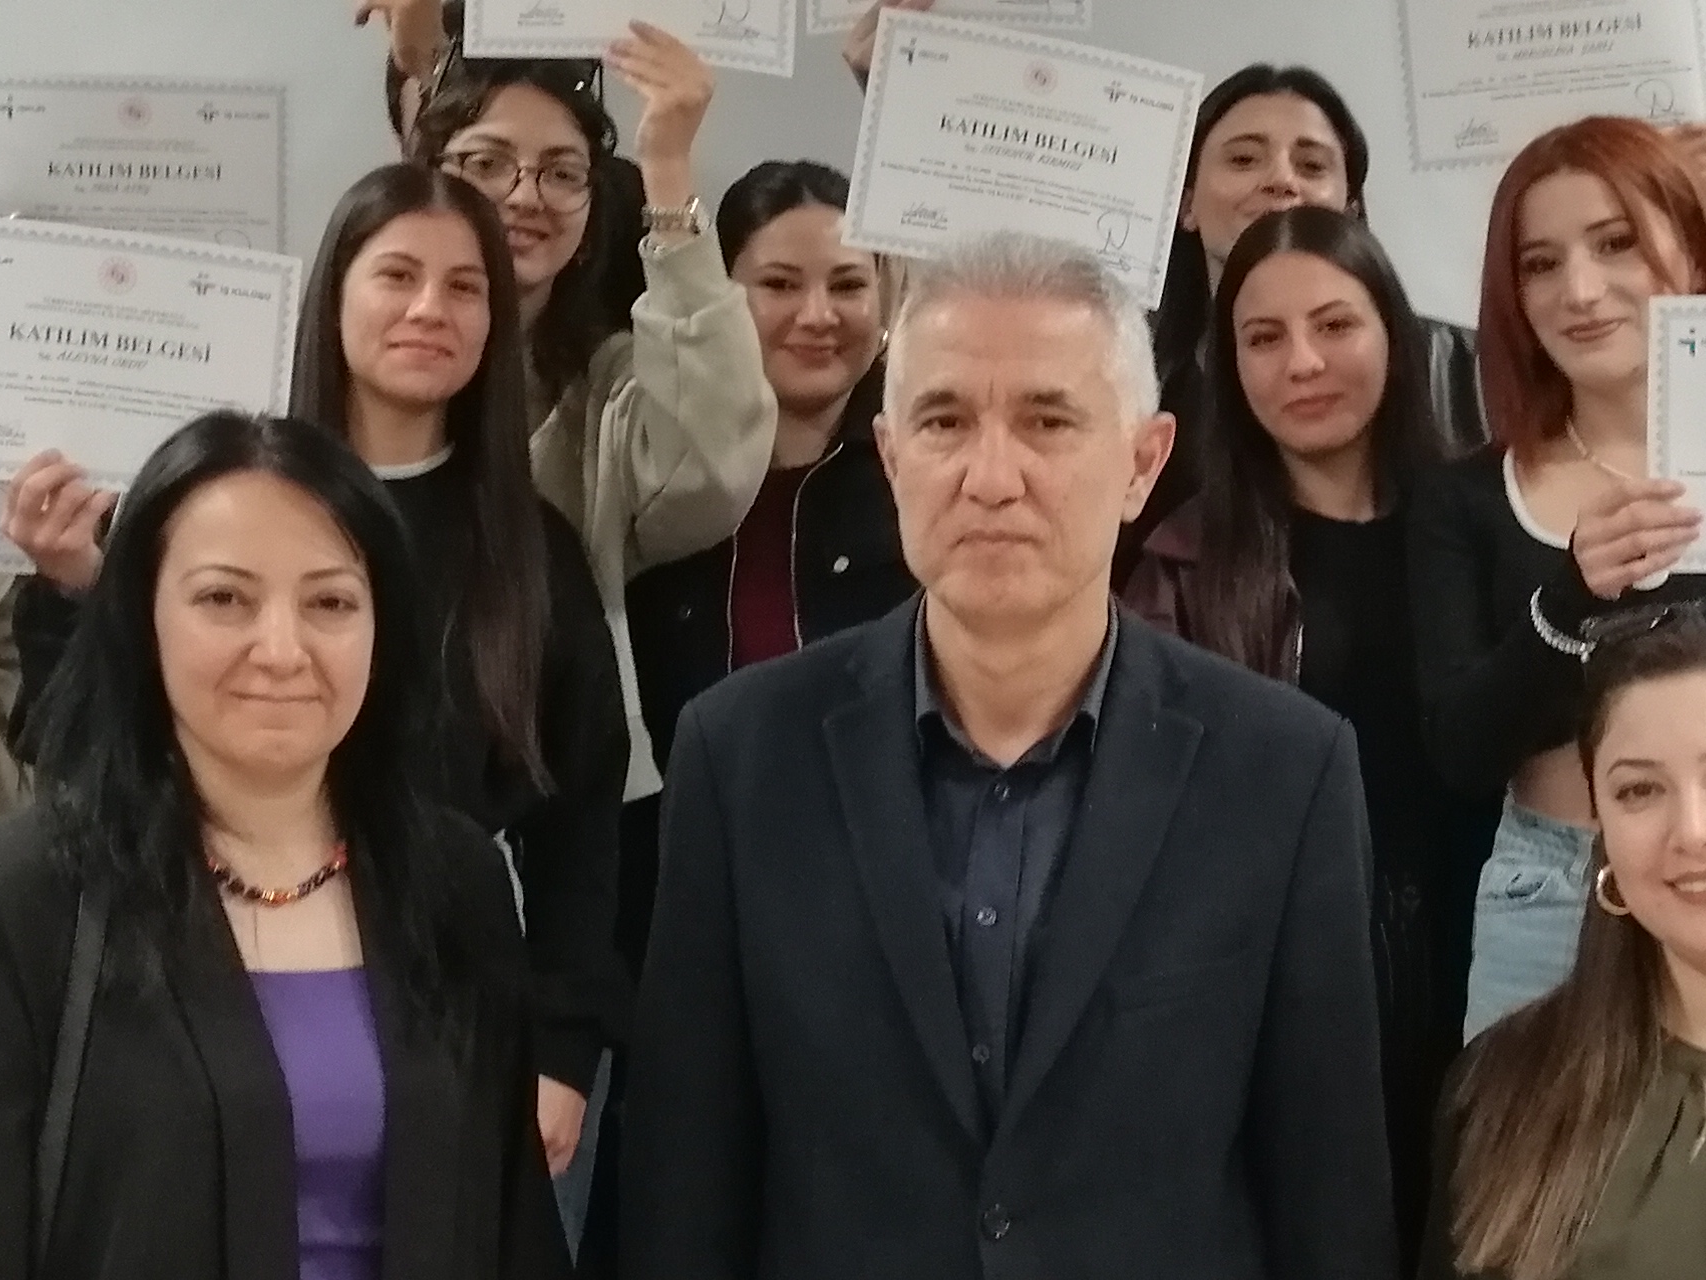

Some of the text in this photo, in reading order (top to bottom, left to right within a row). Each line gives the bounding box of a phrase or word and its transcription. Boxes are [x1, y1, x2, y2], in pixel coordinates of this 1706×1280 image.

[939, 113, 1030, 146] KATILIM
[9, 322, 213, 364] KATILIM BELGESİ
